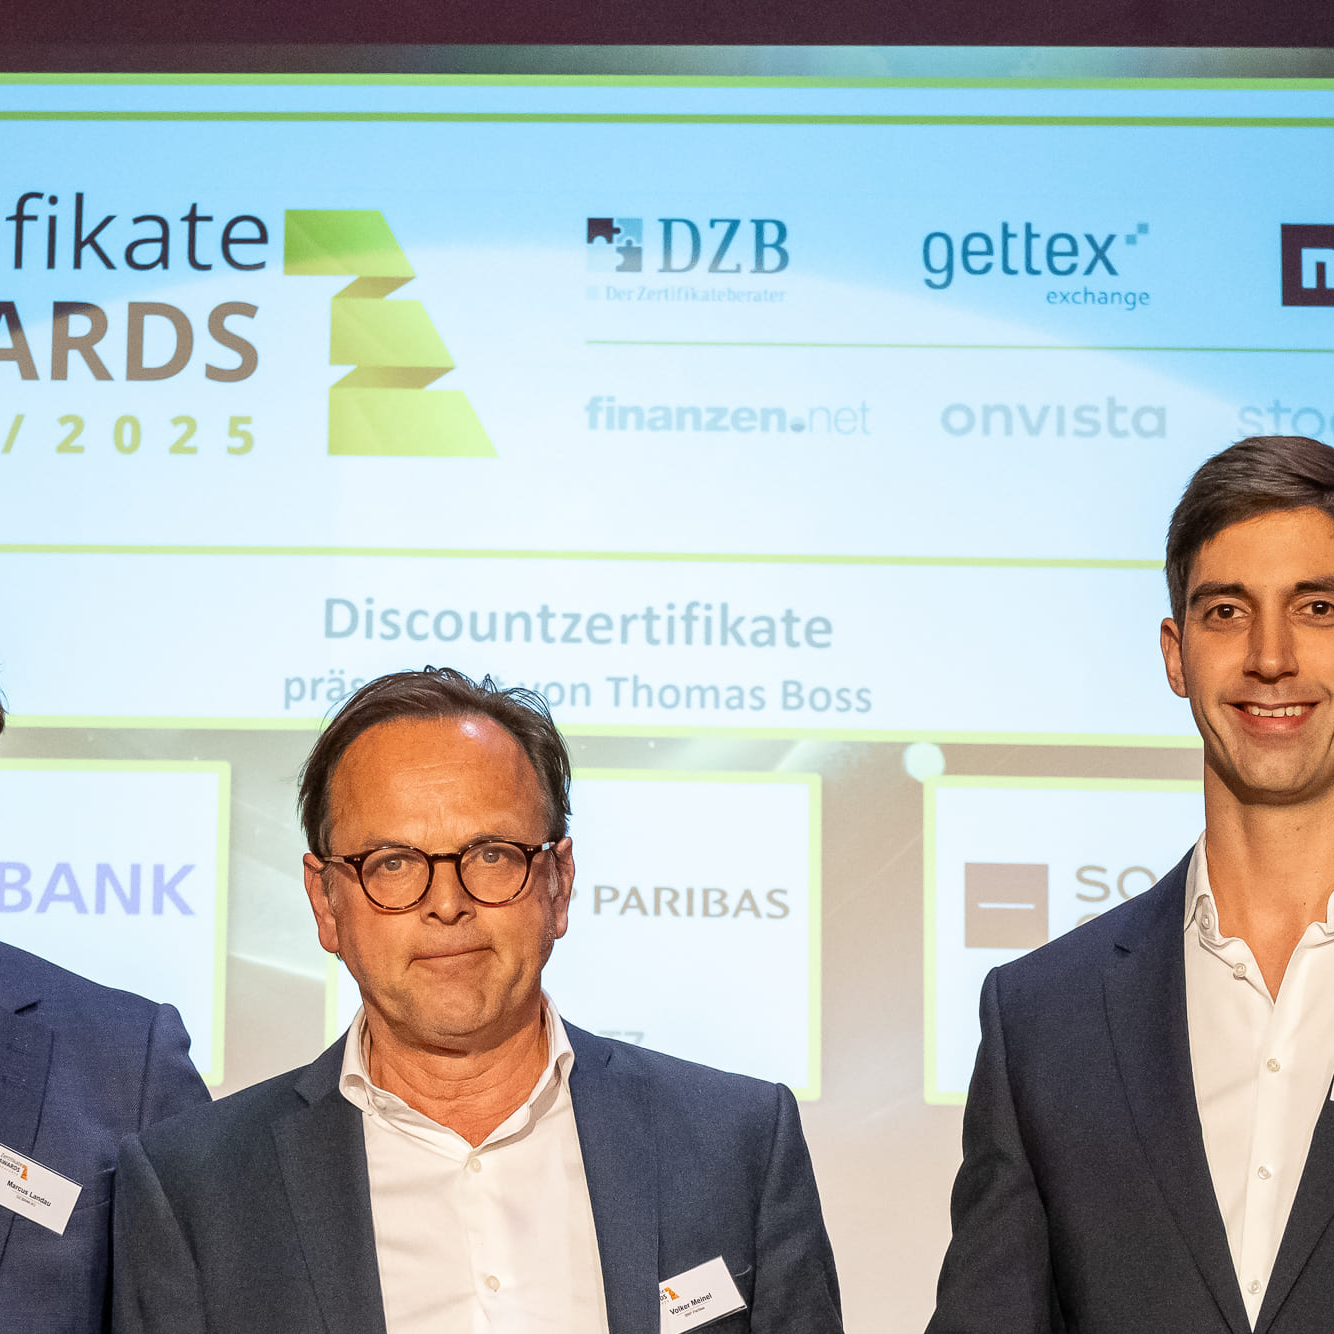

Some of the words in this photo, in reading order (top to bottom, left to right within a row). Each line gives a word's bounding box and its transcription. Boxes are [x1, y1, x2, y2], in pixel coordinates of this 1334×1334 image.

[657, 218, 789, 274] DZB
[922, 221, 1120, 290] gettex
[1046, 286, 1151, 311] exchange
[584, 395, 872, 436] finanzen.net
[940, 397, 1167, 440] onvista
[323, 597, 835, 650] Discountzertifikate
[605, 675, 767, 712] Thomas
[781, 680, 873, 714] Boss
[593, 885, 790, 920] PARIBAS
[6, 1180, 29, 1196] Marcus
[29, 1191, 52, 1207] Landau
